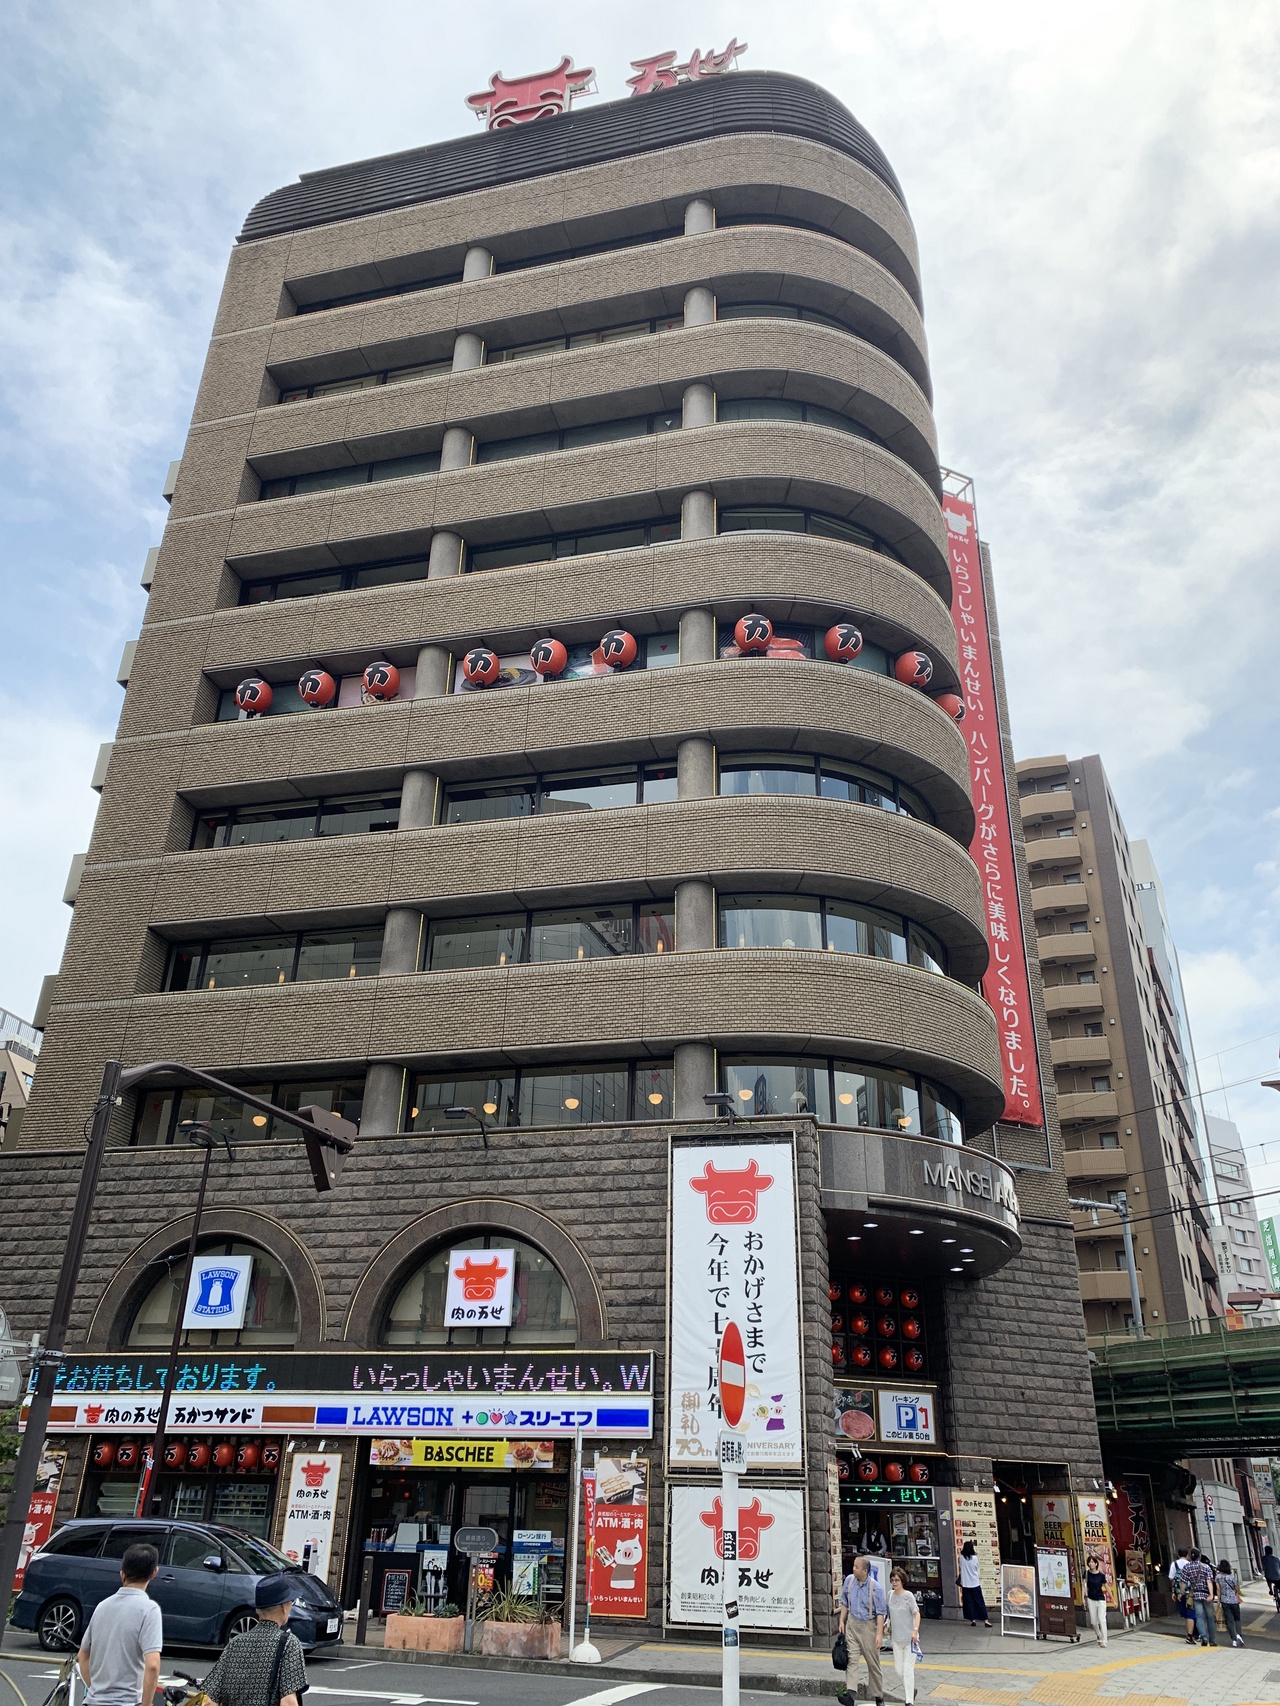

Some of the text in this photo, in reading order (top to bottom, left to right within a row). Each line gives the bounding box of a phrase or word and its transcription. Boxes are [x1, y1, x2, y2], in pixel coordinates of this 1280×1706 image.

[969, 730, 1030, 1110] ハンバーグがさらに美味しくなりました。
[923, 1160, 993, 1201] MANSEI
[196, 1270, 237, 1314] LAWSON STATION
[743, 1230, 767, 1374] おかげさまで
[451, 1305, 505, 1320] 肉の万世
[892, 1395, 920, 1404] パーキング
[105, 1406, 256, 1424] 肉の万世 万かつサンド
[352, 1406, 593, 1427] LAWSON スリーエフ
[681, 1391, 700, 1435] 御礼
[886, 1431, 930, 1441] このビル裏 50台
[424, 1445, 495, 1462] BASCHEE
[747, 1442, 796, 1450] NIVERSARY
[296, 1489, 329, 1499] 肉の万世
[28, 1504, 52, 1514] ・酒・肉
[1044, 1521, 1063, 1530] BEER
[1085, 1520, 1104, 1529] BEER
[1044, 1530, 1065, 1541] HALL
[1084, 1528, 1107, 1539] HALL
[701, 1566, 774, 1589] 肉万世
